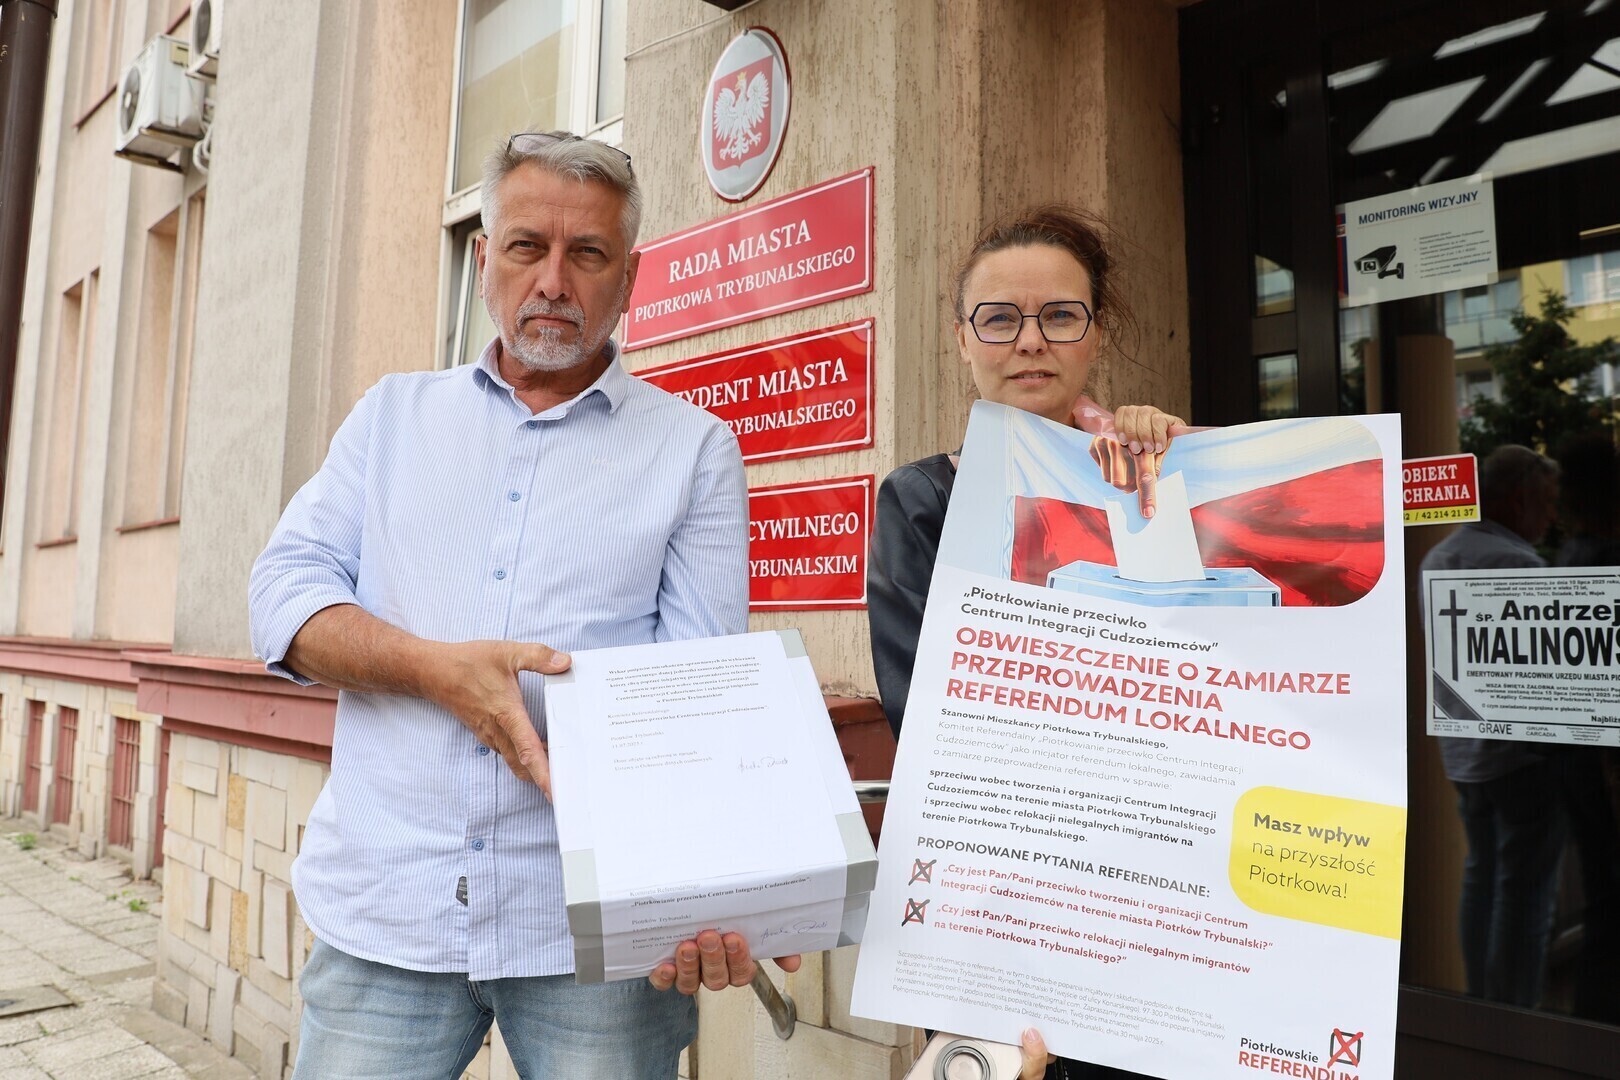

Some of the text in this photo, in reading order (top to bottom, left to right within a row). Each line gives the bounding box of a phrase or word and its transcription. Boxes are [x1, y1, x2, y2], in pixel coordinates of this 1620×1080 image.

[1359, 191, 1478, 225] MONITORING WIZYJNY
[669, 219, 812, 283] RADA MIASTA
[635, 246, 856, 322] PIOTRKOWA TRYBUNALSKIEGO
[758, 358, 848, 398] MIASTA
[1402, 464, 1458, 483] OBIEKT
[1404, 484, 1470, 504] CHRANIA
[1434, 510, 1449, 519] 214
[1451, 509, 1461, 518] 21
[1464, 508, 1474, 517] 37
[961, 603, 1024, 623] Centrum
[1028, 615, 1095, 638] Integracji
[1073, 609, 1147, 629] przeciwko
[1476, 599, 1620, 626] ŚP. Andrzej
[956, 627, 1350, 694] OBWIESZCZENIE O ZAMIARZE
[952, 652, 1223, 712] PRZEPROWADZENIA
[941, 708, 1169, 749] Szanowni Mieszkańcy Piotrkowa Trybunalskiego,
[947, 678, 1311, 750] REFERENDUM LOKALNEGO
[1478, 722, 1512, 735] GRAVE
[938, 721, 974, 733] Komitet
[976, 726, 1036, 743] Referendalny
[1107, 747, 1154, 760] przeciwko
[1156, 753, 1198, 766] Centrum
[1200, 760, 1244, 775] Integracji
[1010, 745, 1030, 754] jako
[1032, 750, 1069, 760] inicjator
[1072, 754, 1126, 768] referendum
[1128, 762, 1177, 778] lokalnego,
[1180, 772, 1236, 786] zawiadamia
[942, 750, 982, 761] zamiarze
[984, 756, 1062, 772] przeprowadzenia
[1065, 767, 1120, 781] referendum
[1133, 779, 1172, 790] sprawie:
[927, 782, 999, 798] Cudzoziemców
[1015, 795, 1049, 806] terenie
[1052, 801, 1085, 812] miasta
[1087, 805, 1138, 820] Piotrkowa
[1140, 813, 1216, 835] Trybunalskiego
[930, 770, 977, 781] sprzeciwu
[980, 776, 1010, 786] wobec
[1013, 780, 1061, 793] tworzenia
[1068, 790, 1122, 804] organizacji
[1124, 797, 1167, 810] Centrum
[1170, 804, 1217, 820] Integracji
[922, 812, 1088, 842] terenie Piotrkowa Trybunalskiego.
[930, 799, 978, 810] sprzeciwu
[980, 805, 1012, 815] wobec
[1014, 810, 1056, 823] relokacji
[1058, 816, 1120, 832] nielegalnych
[1122, 825, 1179, 844] imigrantów
[1254, 813, 1370, 848] Masz wpływ
[918, 837, 1210, 898] PROPONOWANE PYTANIA REFERENDALNE:
[1252, 843, 1375, 876] na przyszłość
[967, 867, 986, 877] jest
[989, 869, 1034, 885] Pan/Pani
[1036, 880, 1087, 896] przeciwko
[1089, 890, 1139, 907] tworzeniu
[1142, 900, 1145, 908] i
[1147, 903, 1202, 921] organizacji
[1204, 913, 1248, 930] Centrum
[1250, 864, 1347, 899] Piotrkowa!
[941, 879, 987, 894] Integracji
[990, 886, 1064, 908] Cudzoziemców
[1081, 905, 1117, 920] terenie
[1119, 914, 1153, 927] miasta
[1156, 919, 1201, 937] Piotrków
[950, 922, 984, 935] terenie
[986, 928, 1036, 946] Piotrkowa
[961, 909, 980, 918] jest
[982, 910, 1027, 927] Pan/Pani
[1029, 922, 1081, 938] przeciwko
[1083, 933, 1126, 949] relokacji
[1129, 942, 1190, 961] nielegalnym
[1192, 954, 1251, 974] imigrantów
[1240, 1038, 1319, 1063] Piotrkowskie
